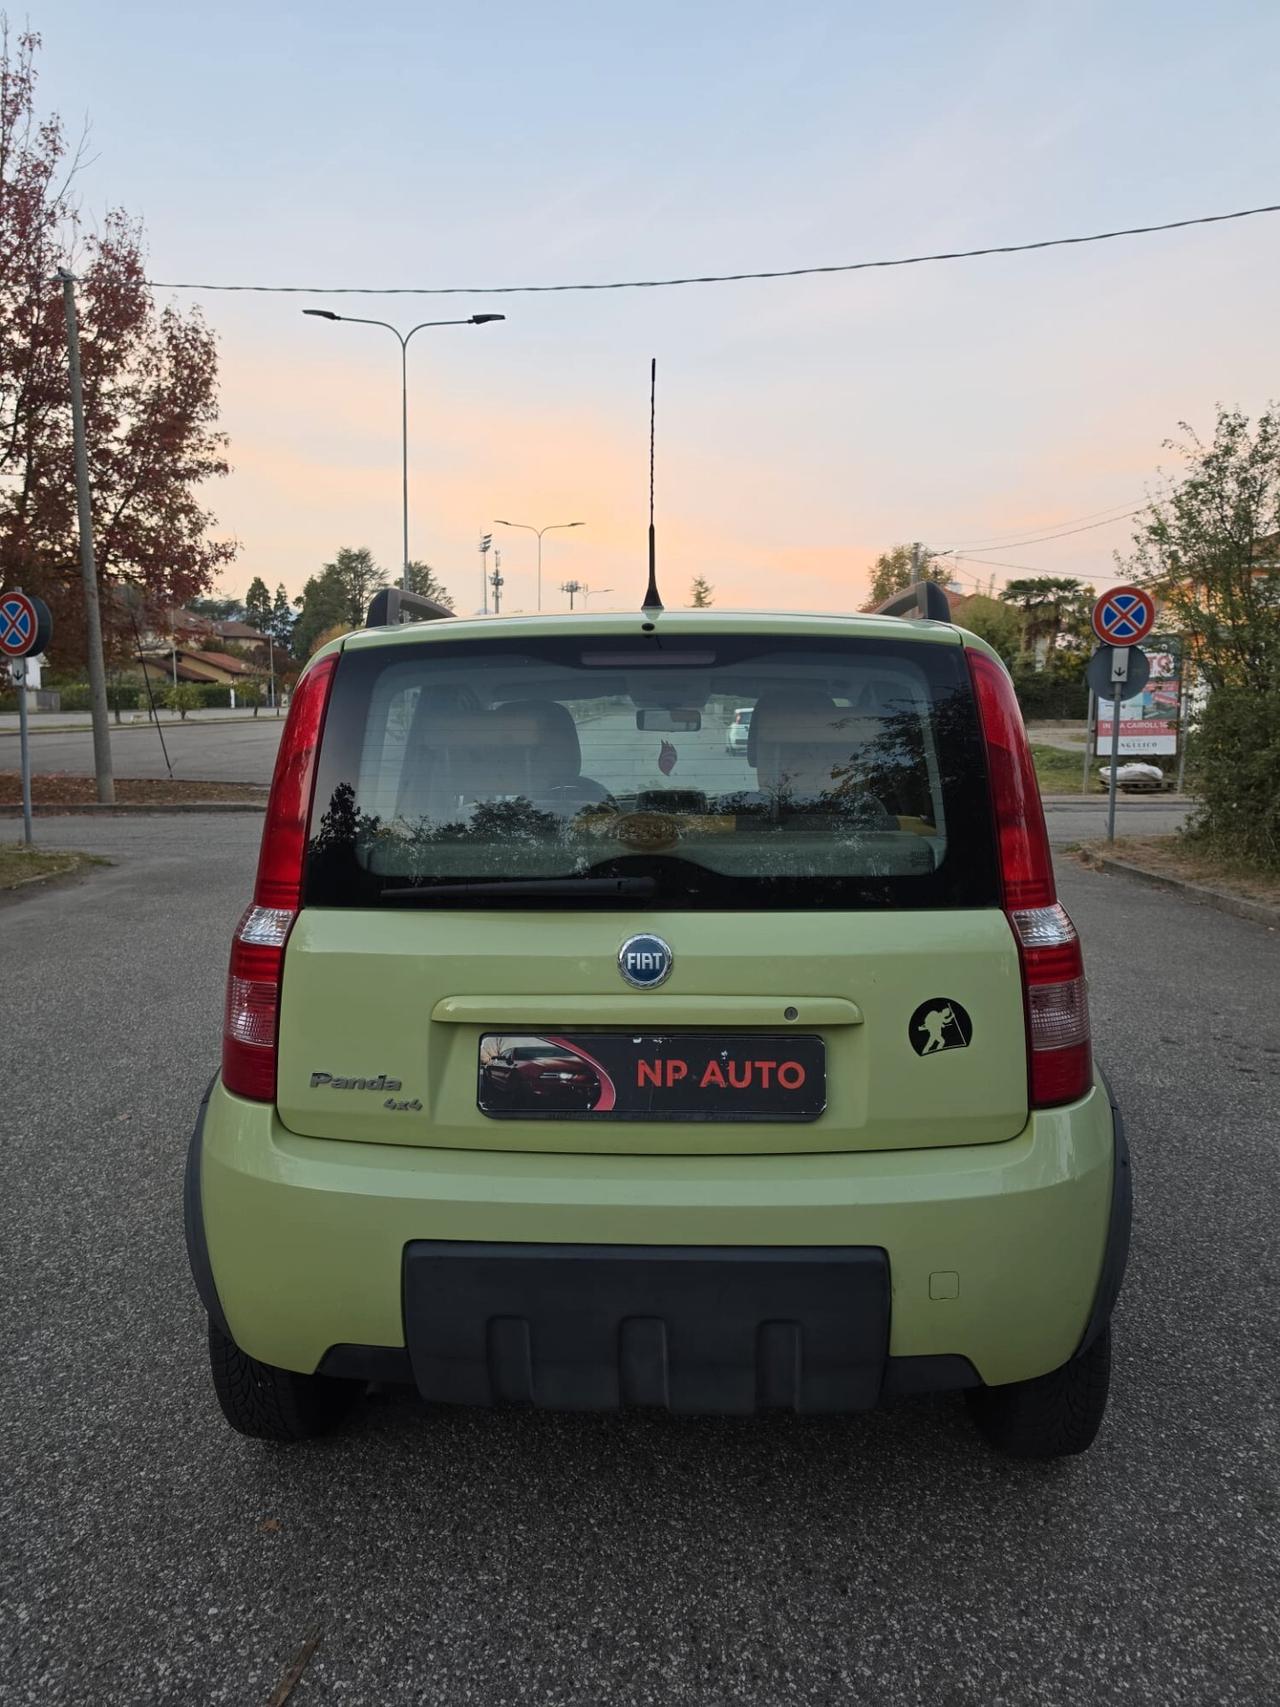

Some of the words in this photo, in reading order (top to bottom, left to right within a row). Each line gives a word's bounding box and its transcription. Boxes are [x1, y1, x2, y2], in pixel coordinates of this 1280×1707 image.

[627, 952, 662, 970] FIAT
[310, 1072, 402, 1091] Panda
[637, 1059, 688, 1088] NP
[700, 1060, 806, 1090] AUTO
[383, 1098, 423, 1111] 4x4
